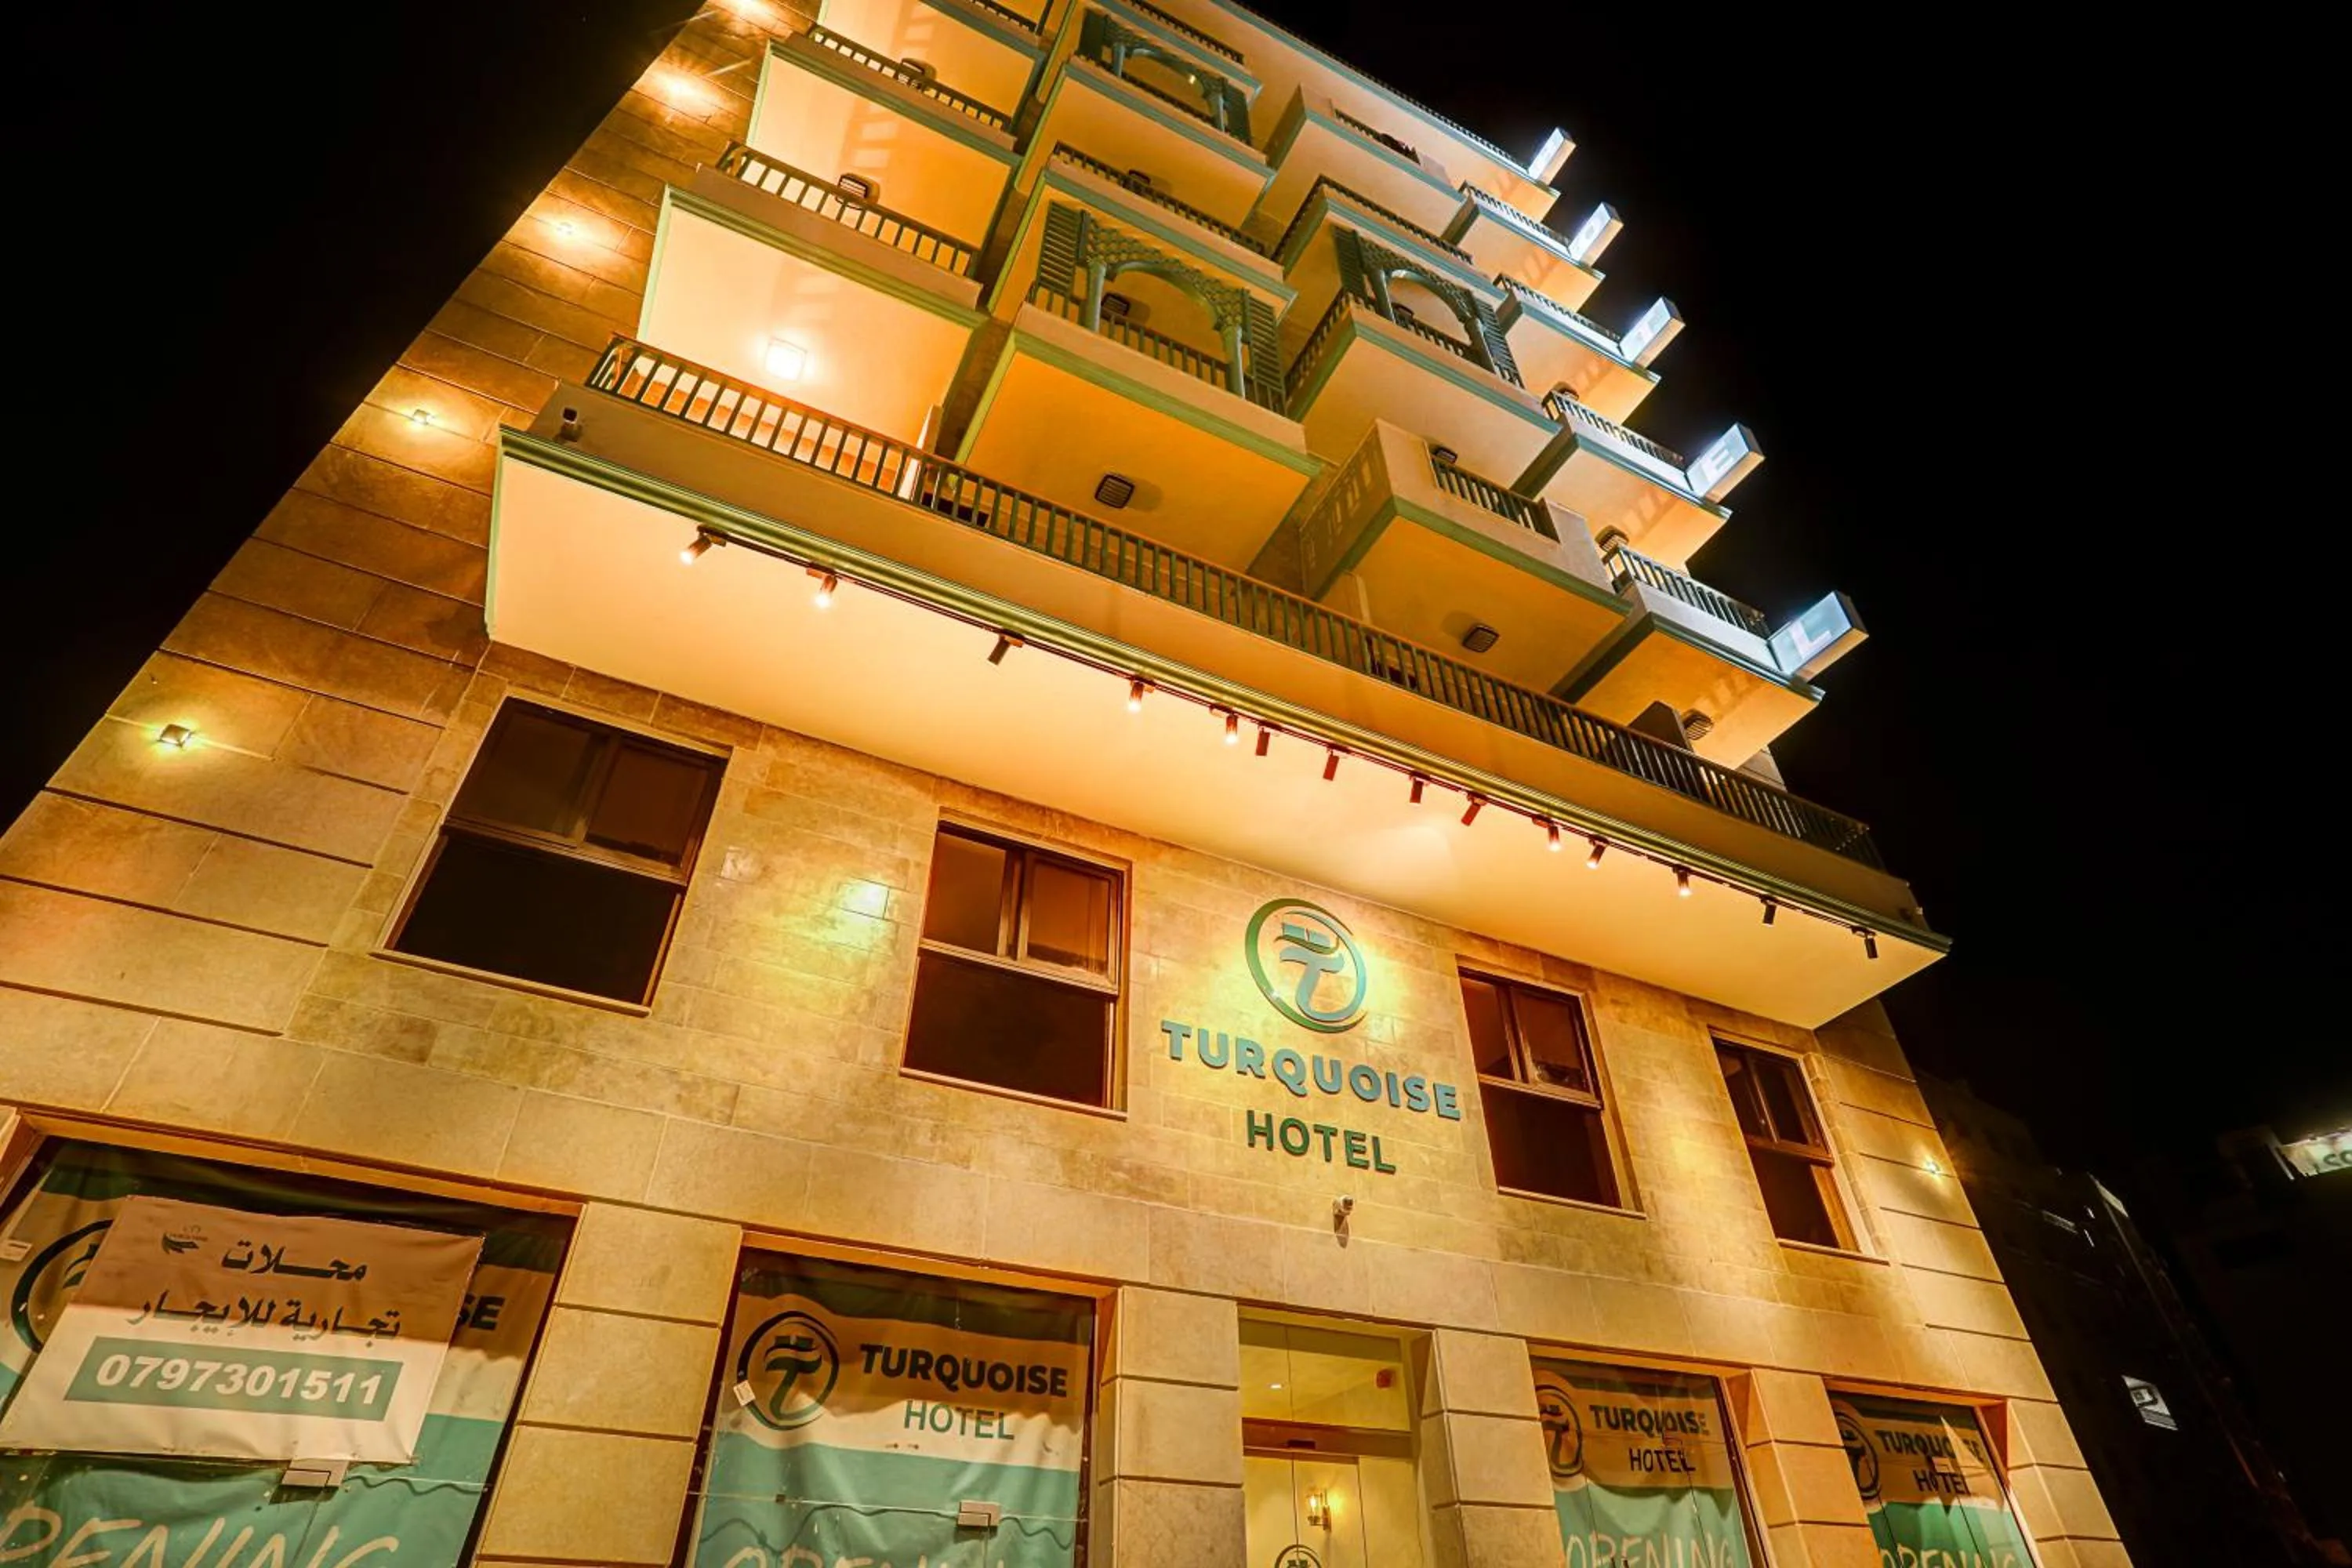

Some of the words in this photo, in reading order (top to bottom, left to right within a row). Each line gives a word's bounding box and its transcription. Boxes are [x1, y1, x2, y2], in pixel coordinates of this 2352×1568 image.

[1161, 1020, 1461, 1121] TURQUOISE
[1247, 1109, 1396, 1174] HOTEL
[280, 1298, 401, 1348] تجارية
[96, 1353, 383, 1405] 0797301511
[860, 1343, 1068, 1397] TURQUOISE
[903, 1399, 1014, 1440] HOTEL
[1589, 1405, 1710, 1438] TURQUOISE
[1628, 1447, 1696, 1472] HOTEL
